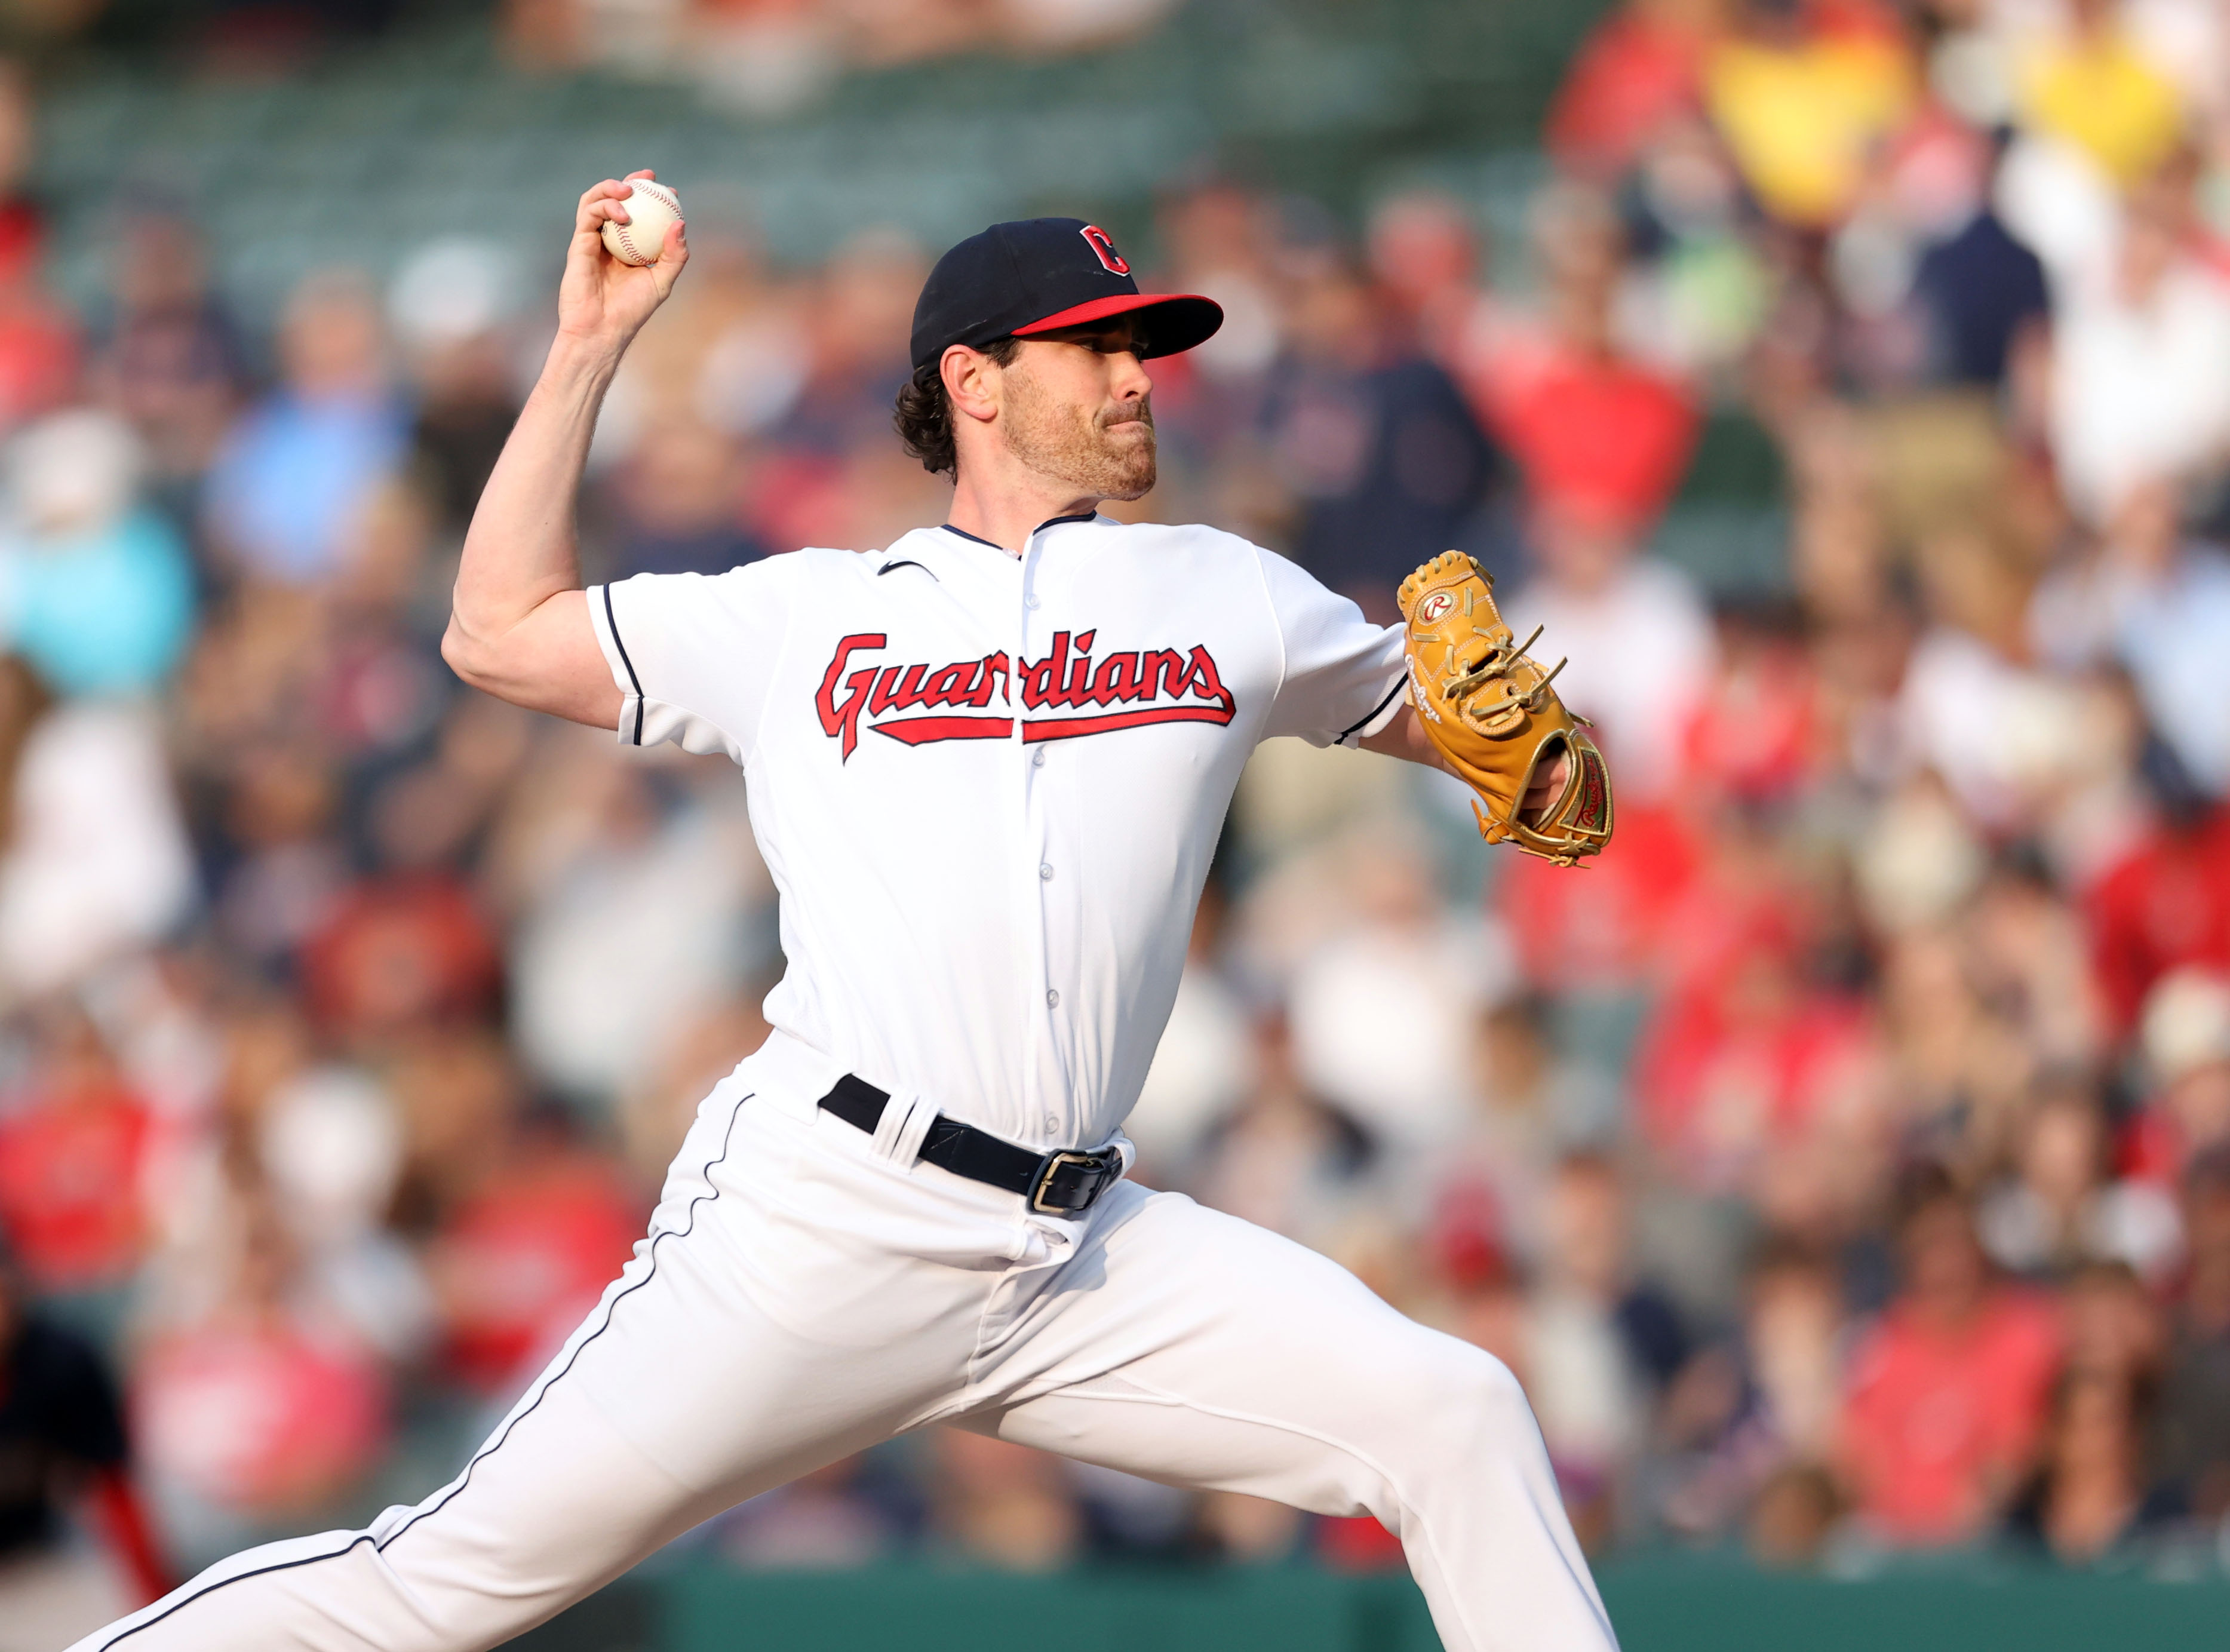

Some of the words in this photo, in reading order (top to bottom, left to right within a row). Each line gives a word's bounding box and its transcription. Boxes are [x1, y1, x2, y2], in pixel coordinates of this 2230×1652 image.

[1079, 225, 1131, 277] C
[1424, 596, 1451, 621] R
[815, 629, 1237, 766] Guardians
